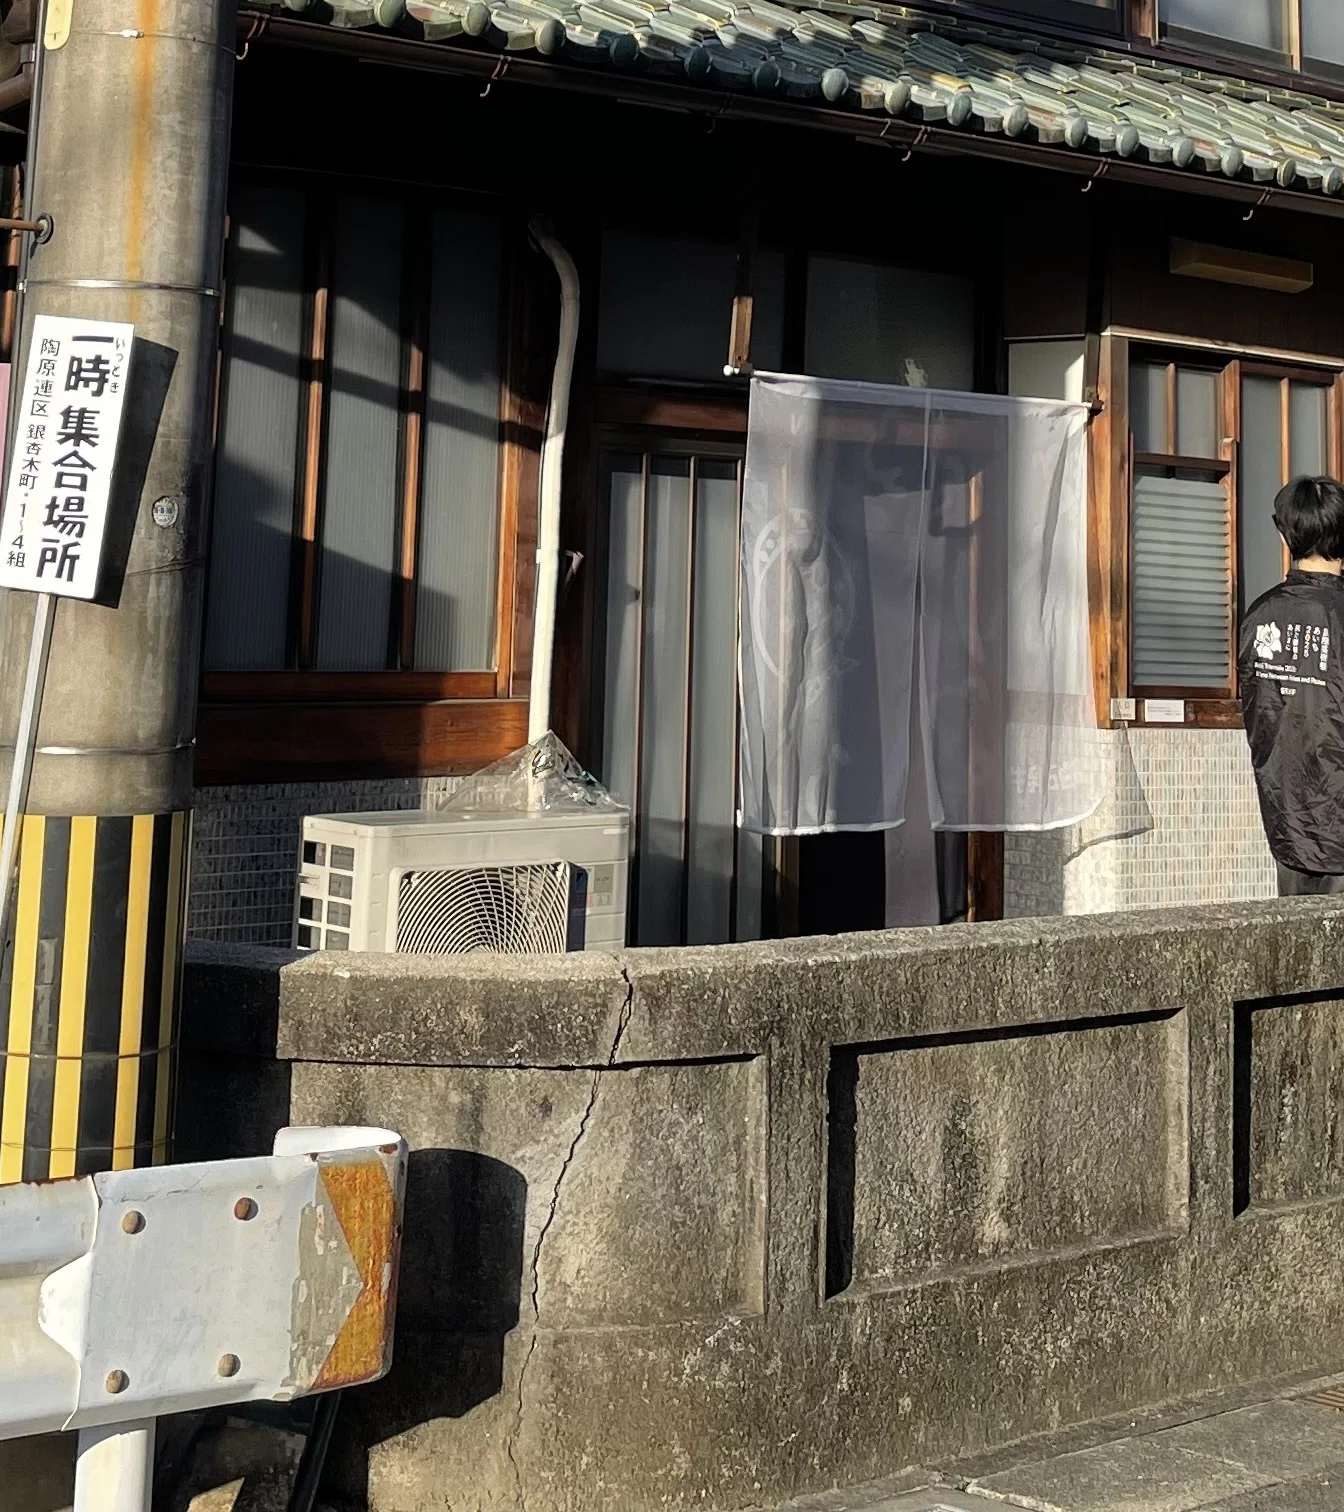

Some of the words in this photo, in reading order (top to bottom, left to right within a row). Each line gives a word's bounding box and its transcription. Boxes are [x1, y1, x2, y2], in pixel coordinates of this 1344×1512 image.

[110, 337, 125, 393] いっとき
[36, 335, 114, 582] 一時集合場所
